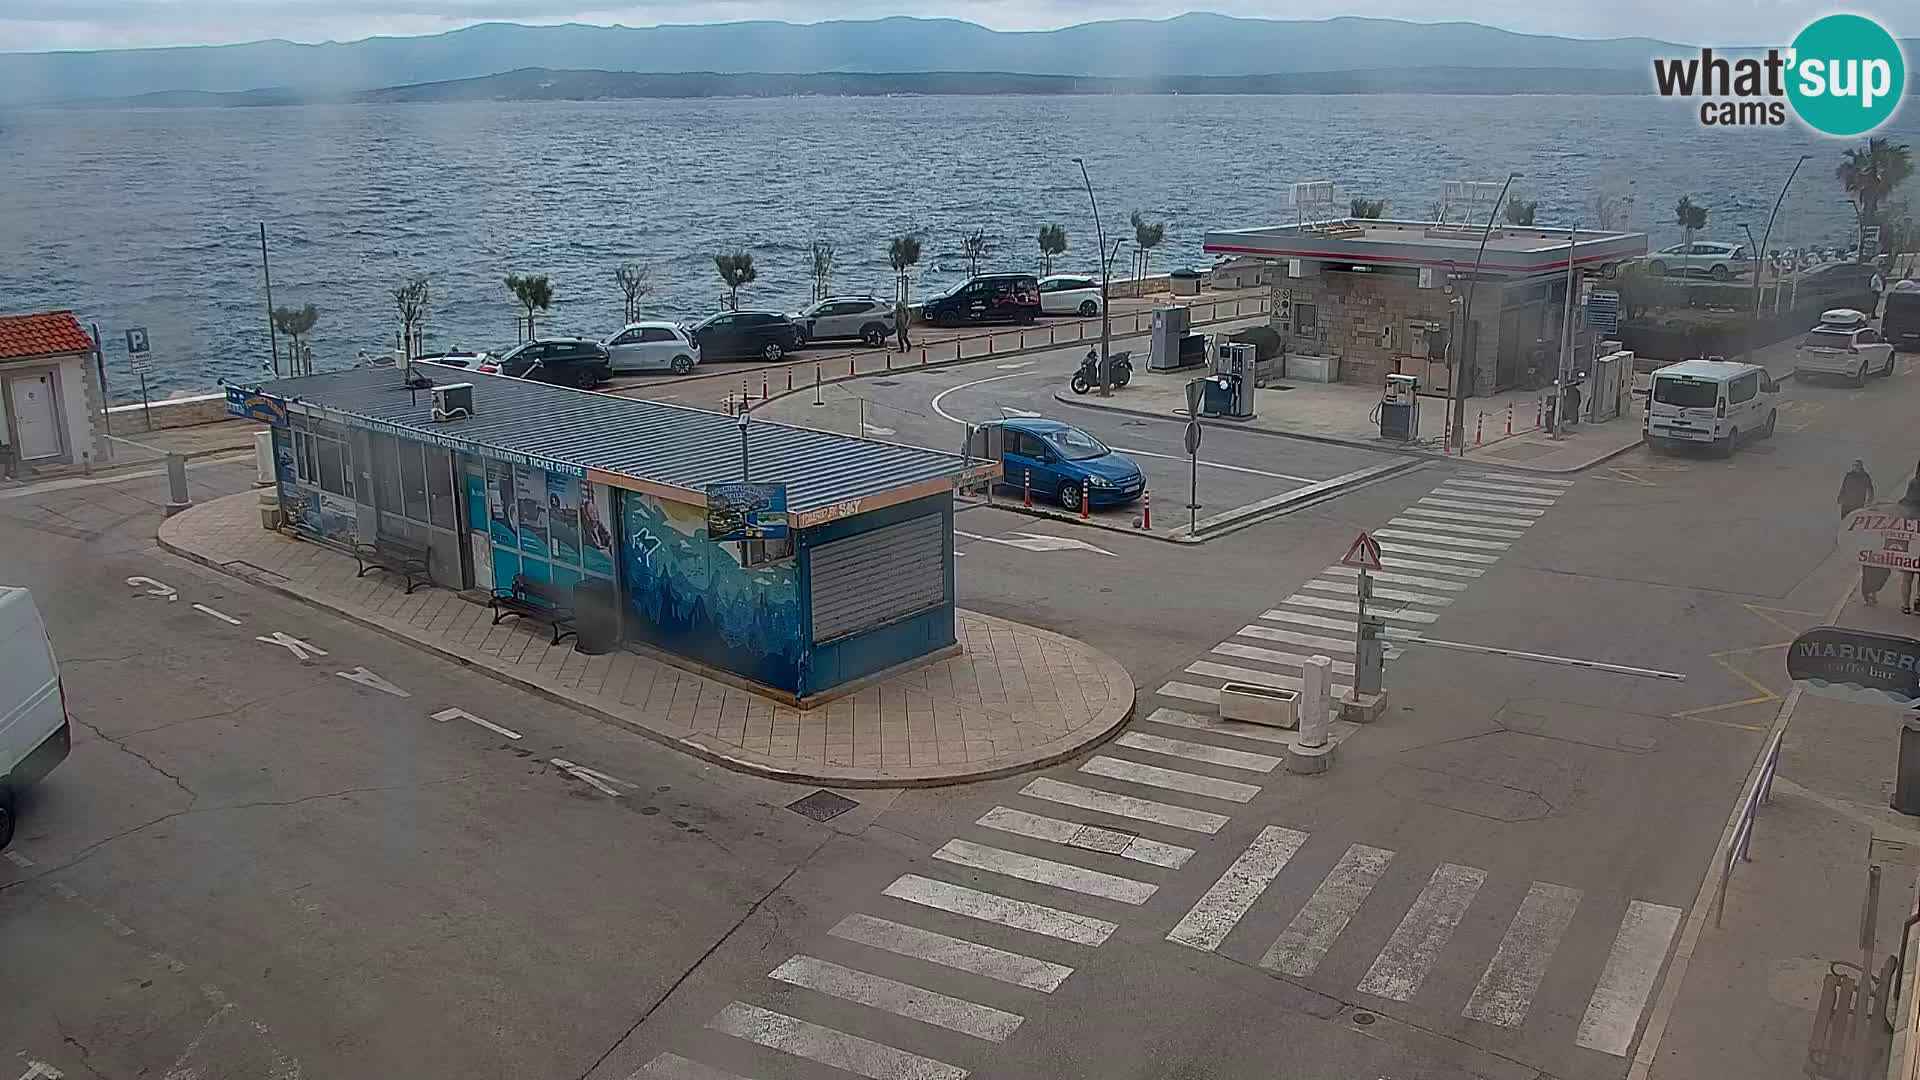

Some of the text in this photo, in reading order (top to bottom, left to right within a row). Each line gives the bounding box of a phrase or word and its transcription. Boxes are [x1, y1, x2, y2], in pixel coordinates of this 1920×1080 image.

[130, 331, 144, 349] P
[495, 449, 527, 465] STATION
[529, 456, 555, 471] TICKET
[556, 463, 583, 477] OFFICE
[1848, 515, 1920, 533] PIZZE
[1869, 665, 1896, 681] bar
